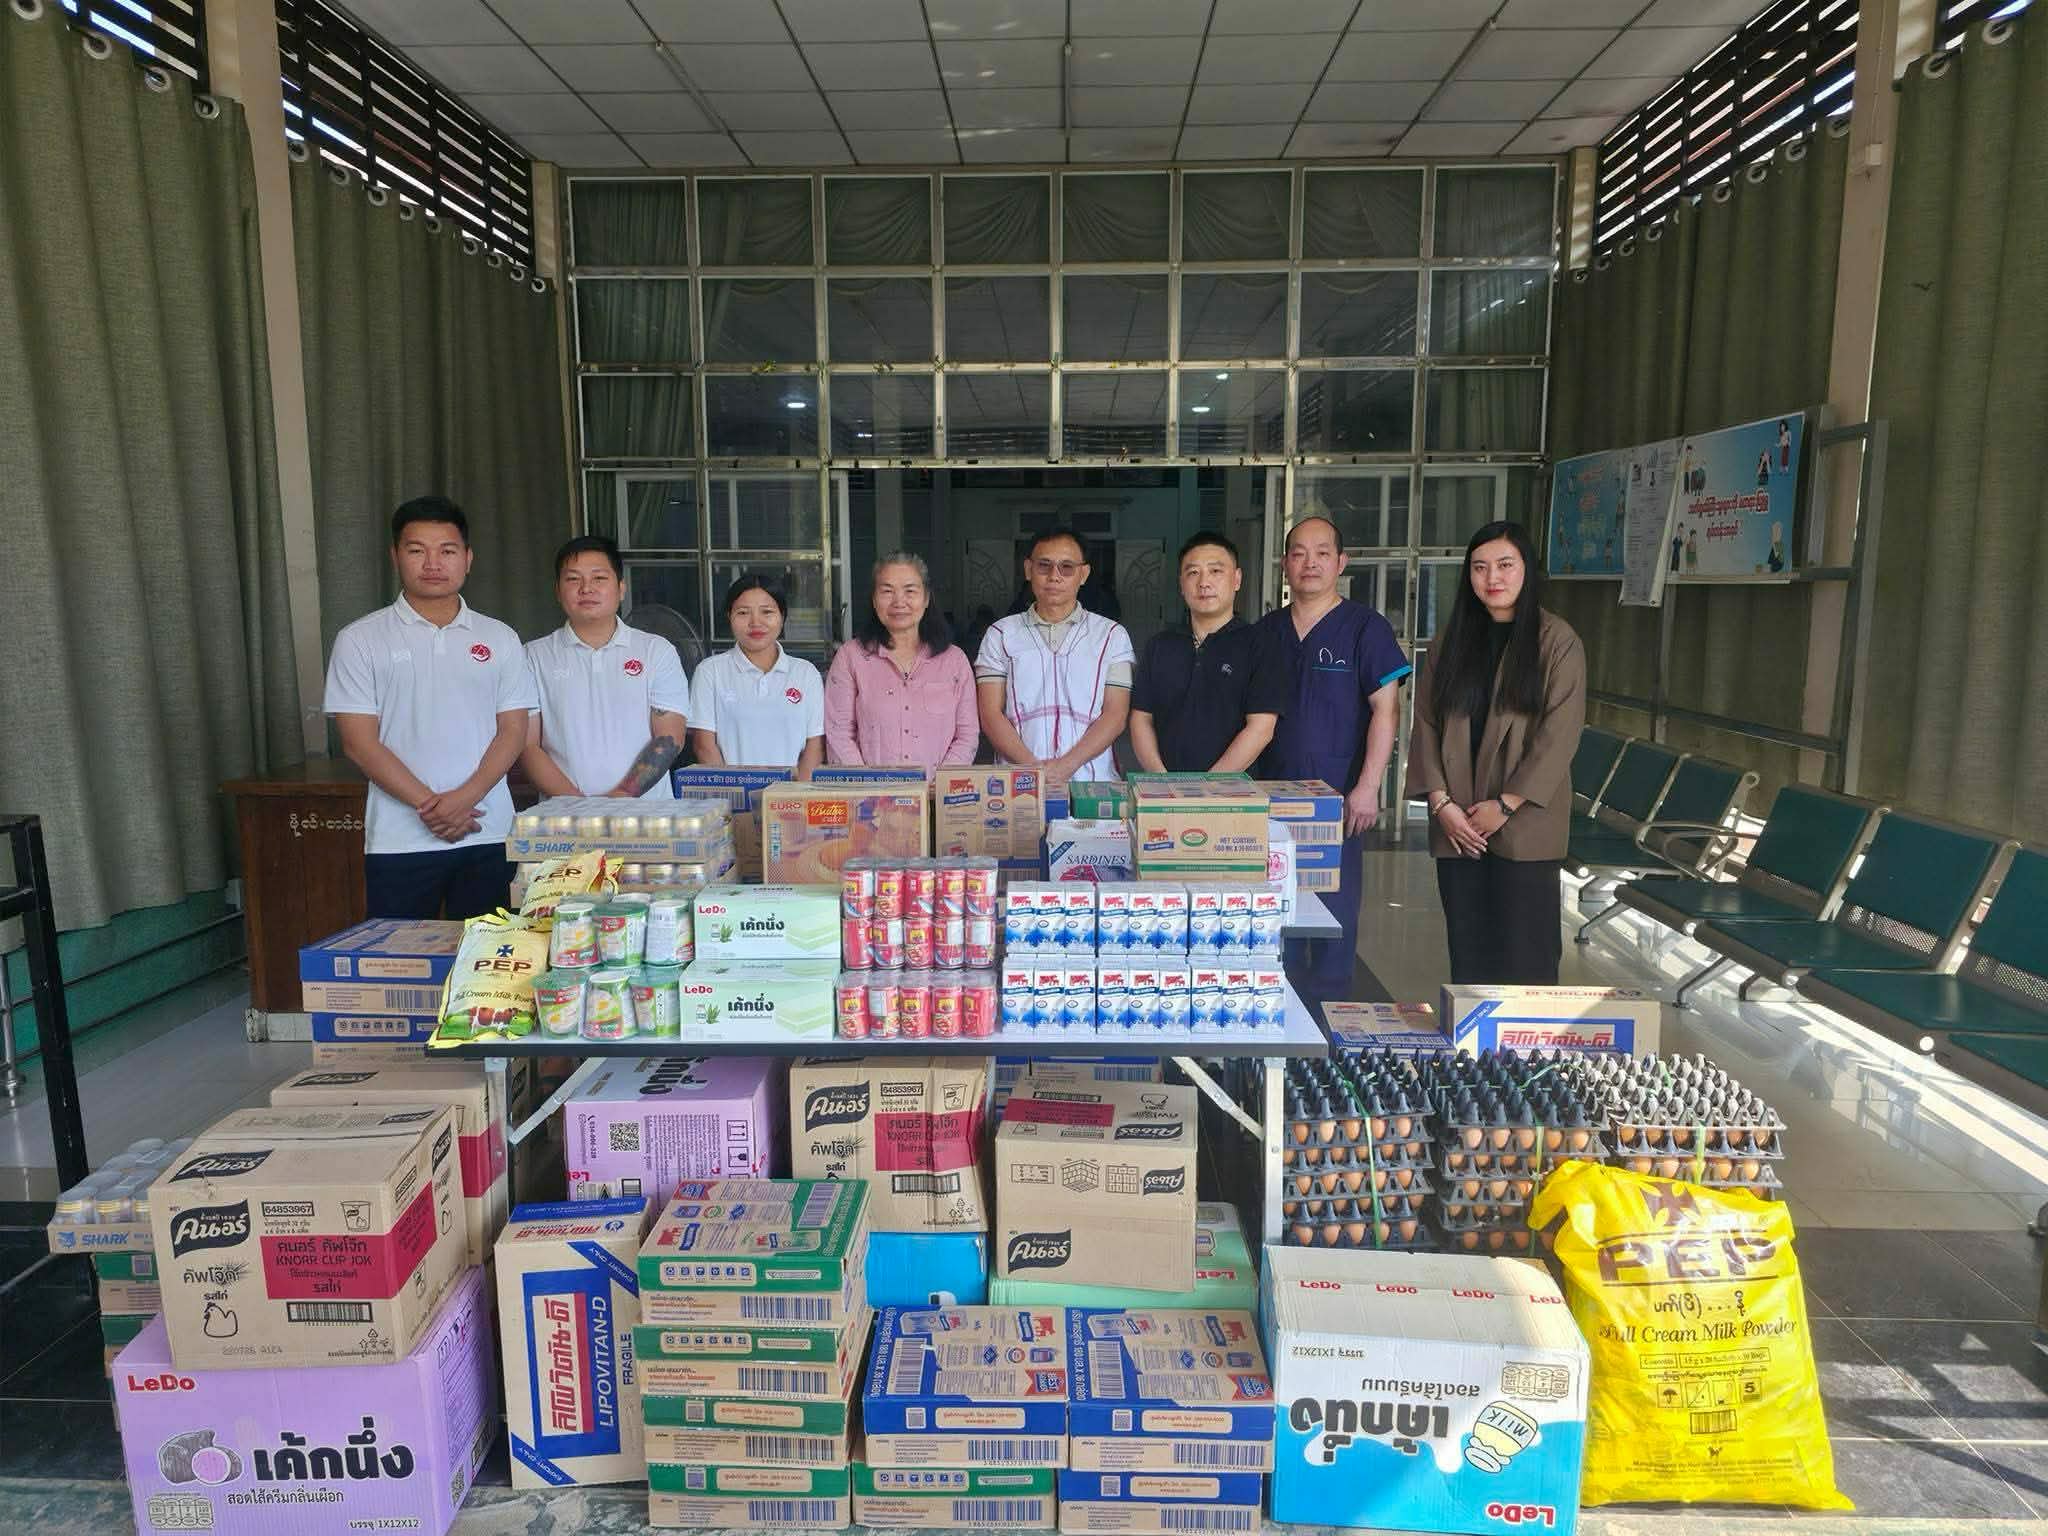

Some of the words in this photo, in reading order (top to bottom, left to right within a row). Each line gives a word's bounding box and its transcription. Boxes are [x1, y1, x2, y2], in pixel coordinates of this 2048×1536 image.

[770, 801, 800, 810] EURO
[809, 804, 846, 817] Butter
[534, 842, 576, 853] SHARK
[1066, 855, 1127, 865] SARDINES
[698, 905, 726, 914] LeDo
[740, 912, 785, 931] เค้กนึ่ง
[473, 960, 532, 972] PEP
[684, 985, 713, 994] LeDo
[728, 993, 775, 1012] เค้กนึ่ง
[807, 1093, 869, 1121] คนอร์
[811, 1138, 853, 1157] คัพโจ๊ก
[826, 1162, 846, 1172] รสไก่
[265, 1205, 312, 1213] 64853967
[174, 1213, 248, 1245] คนอร์
[82, 1232, 128, 1245] SHARK
[278, 1239, 316, 1252] คนอร์
[322, 1236, 367, 1252] คัพโจ๊ก
[276, 1256, 318, 1266] KNORR
[1009, 1240, 1071, 1264] คนอร์
[1598, 1238, 1776, 1282] PEP
[183, 1266, 236, 1284] คัพโจ๊ก
[312, 1279, 342, 1294] รสไก่
[1300, 1280, 1341, 1291] LeDo
[1376, 1284, 1418, 1295] LeDo
[1452, 1288, 1495, 1300] LeDo
[203, 1291, 229, 1301] รสไก่
[1641, 1325, 1698, 1343] Cream
[1702, 1320, 1738, 1341] Milk
[1743, 1317, 1797, 1338] Powder
[543, 1297, 577, 1433] ลิโพวิตัน-ดี
[591, 1296, 614, 1428] LIPOVITAN-D
[620, 1333, 633, 1385] FRAGILE
[127, 1375, 196, 1391] LeDo
[1361, 1377, 1481, 1400] สอดไส้ครีมนม
[1290, 1397, 1450, 1463] เค้กนึ่ง
[253, 1416, 415, 1481] เค้กนึ่ง
[226, 1485, 344, 1505] สอดไส้ครีมกลิ่นเผือก
[377, 1518, 420, 1529] 1X12X12
[1487, 1503, 1556, 1526] LeDo
